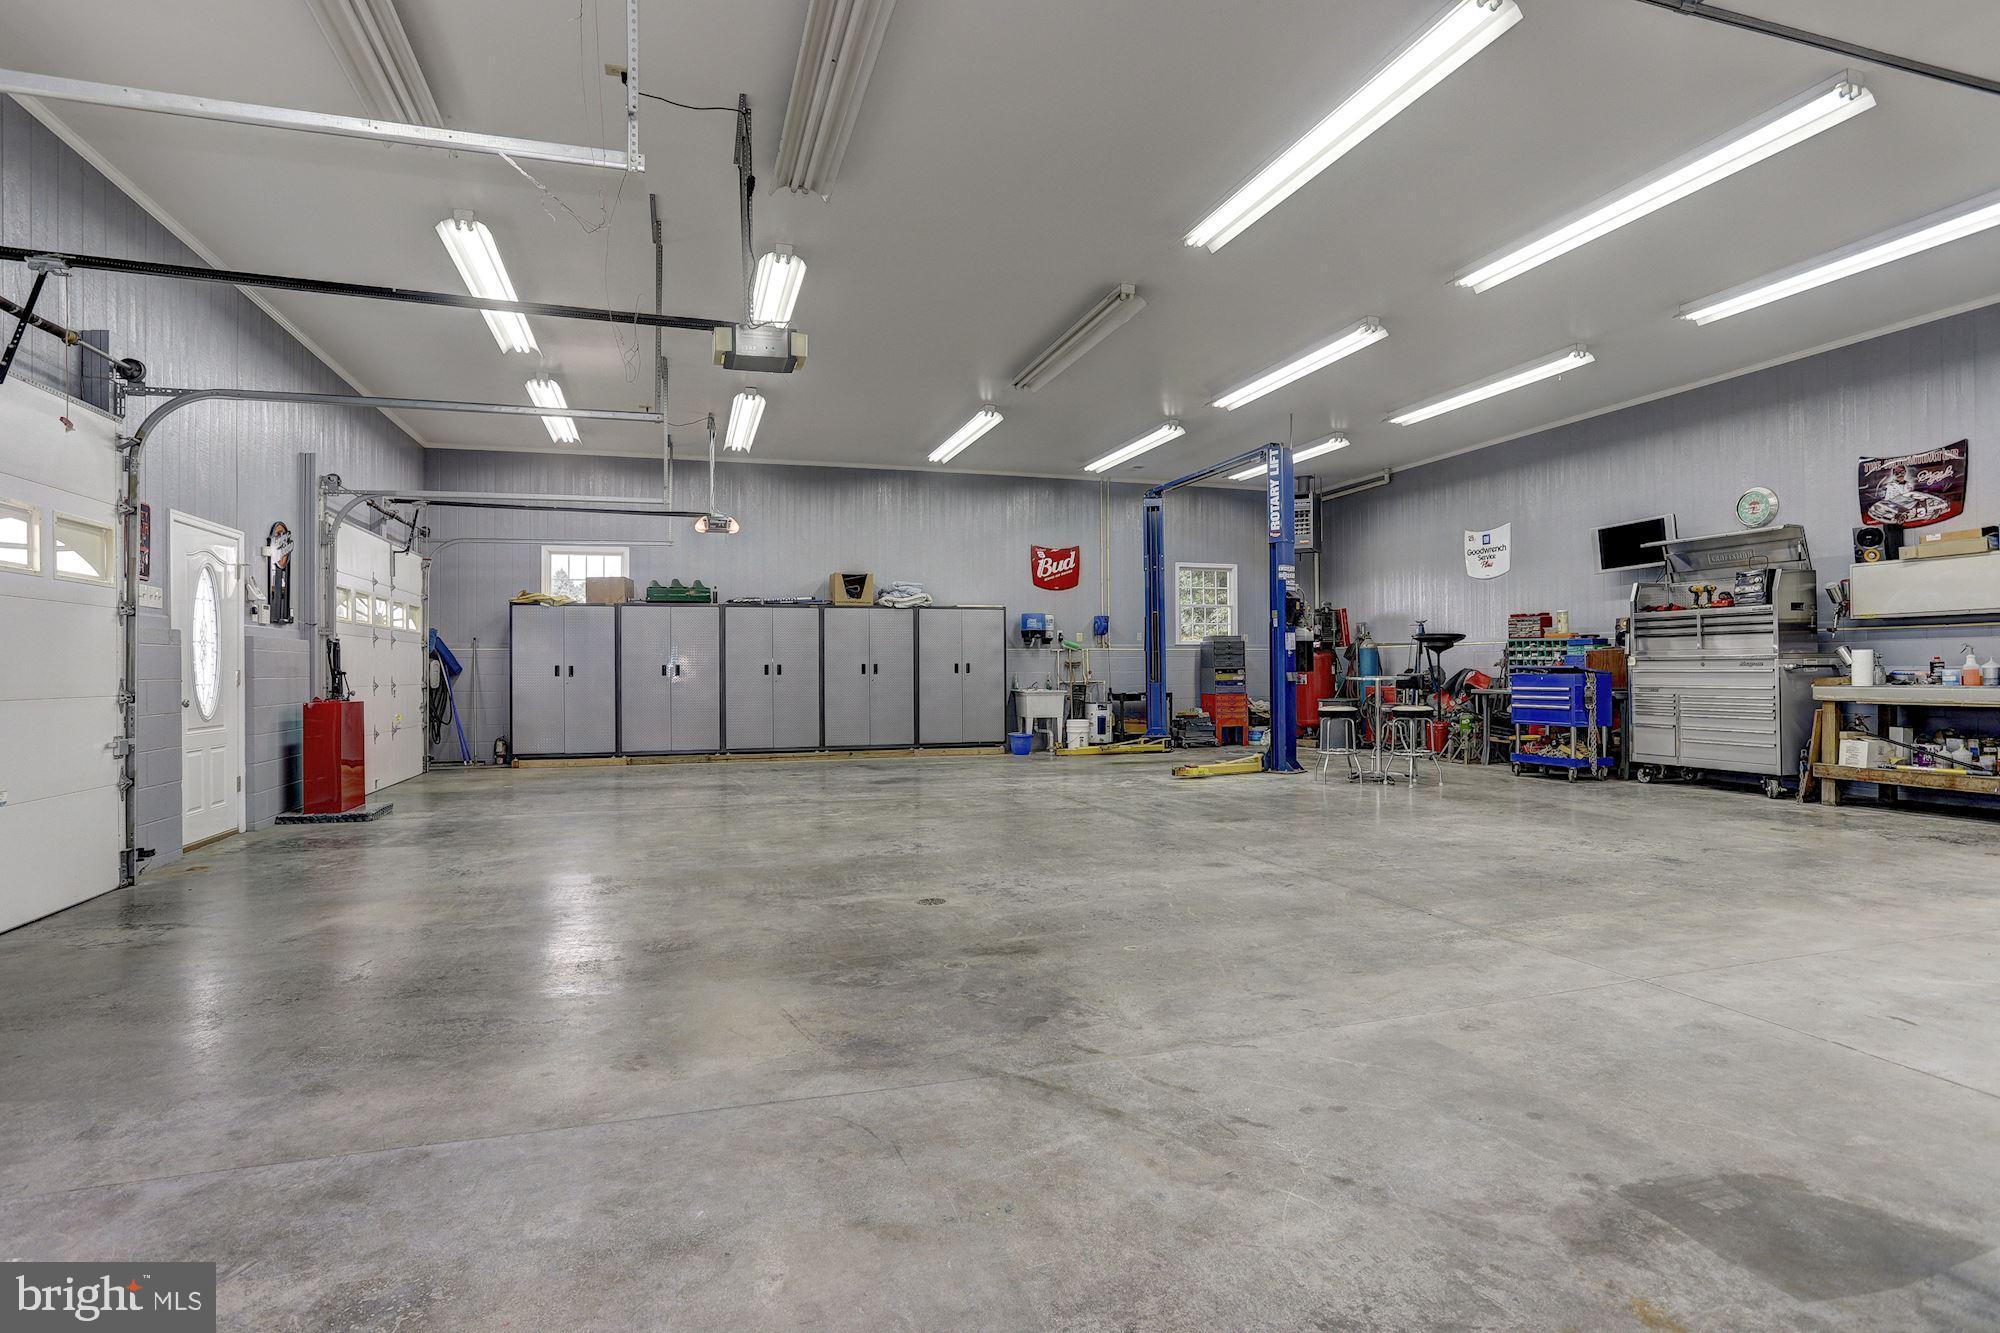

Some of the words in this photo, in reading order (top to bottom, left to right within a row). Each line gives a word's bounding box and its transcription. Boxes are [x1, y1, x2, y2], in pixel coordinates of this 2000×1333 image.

[1269, 448, 1280, 476] LIFT
[1269, 478, 1281, 531] ROTARY
[1467, 543, 1507, 556] Goodwrench
[1037, 550, 1076, 578] Bud
